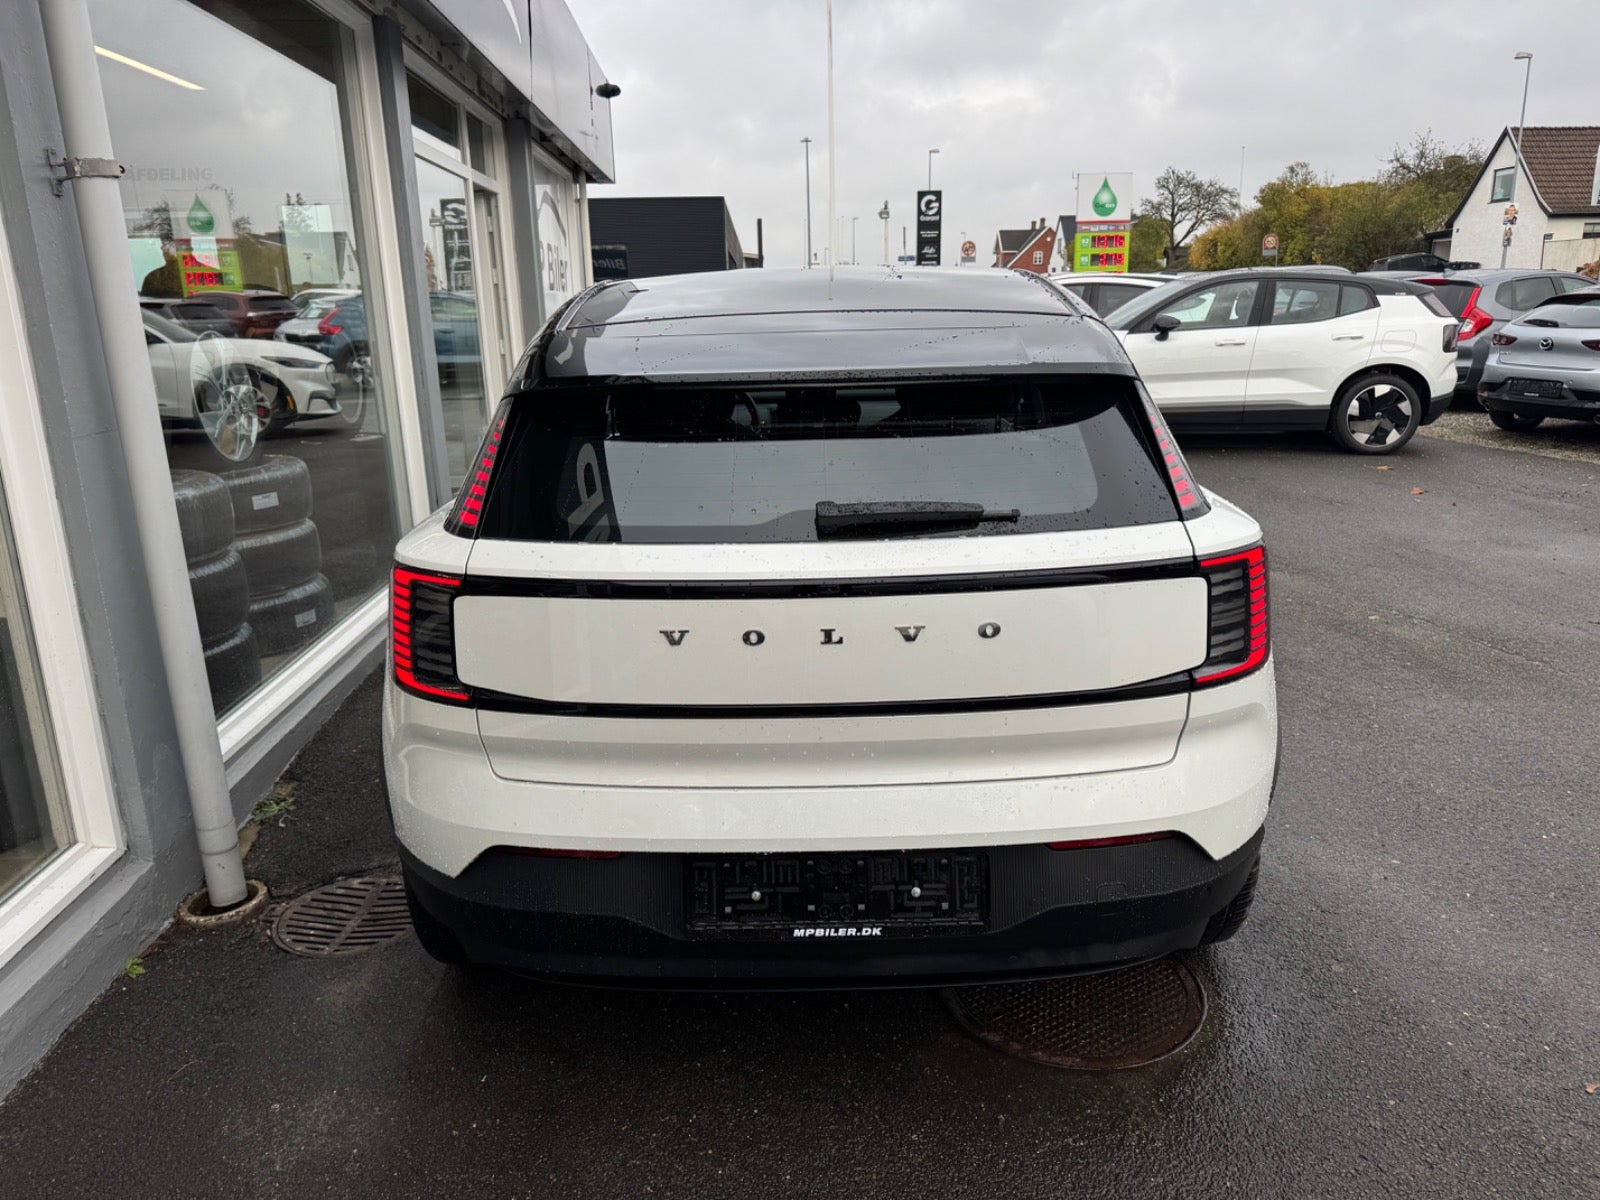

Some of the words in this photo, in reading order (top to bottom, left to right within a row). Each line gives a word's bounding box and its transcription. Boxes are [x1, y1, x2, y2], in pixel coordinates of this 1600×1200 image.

[547, 243, 568, 292] Biler
[659, 621, 1002, 647] VOLVO
[793, 927, 883, 938] MPBILER.DK
